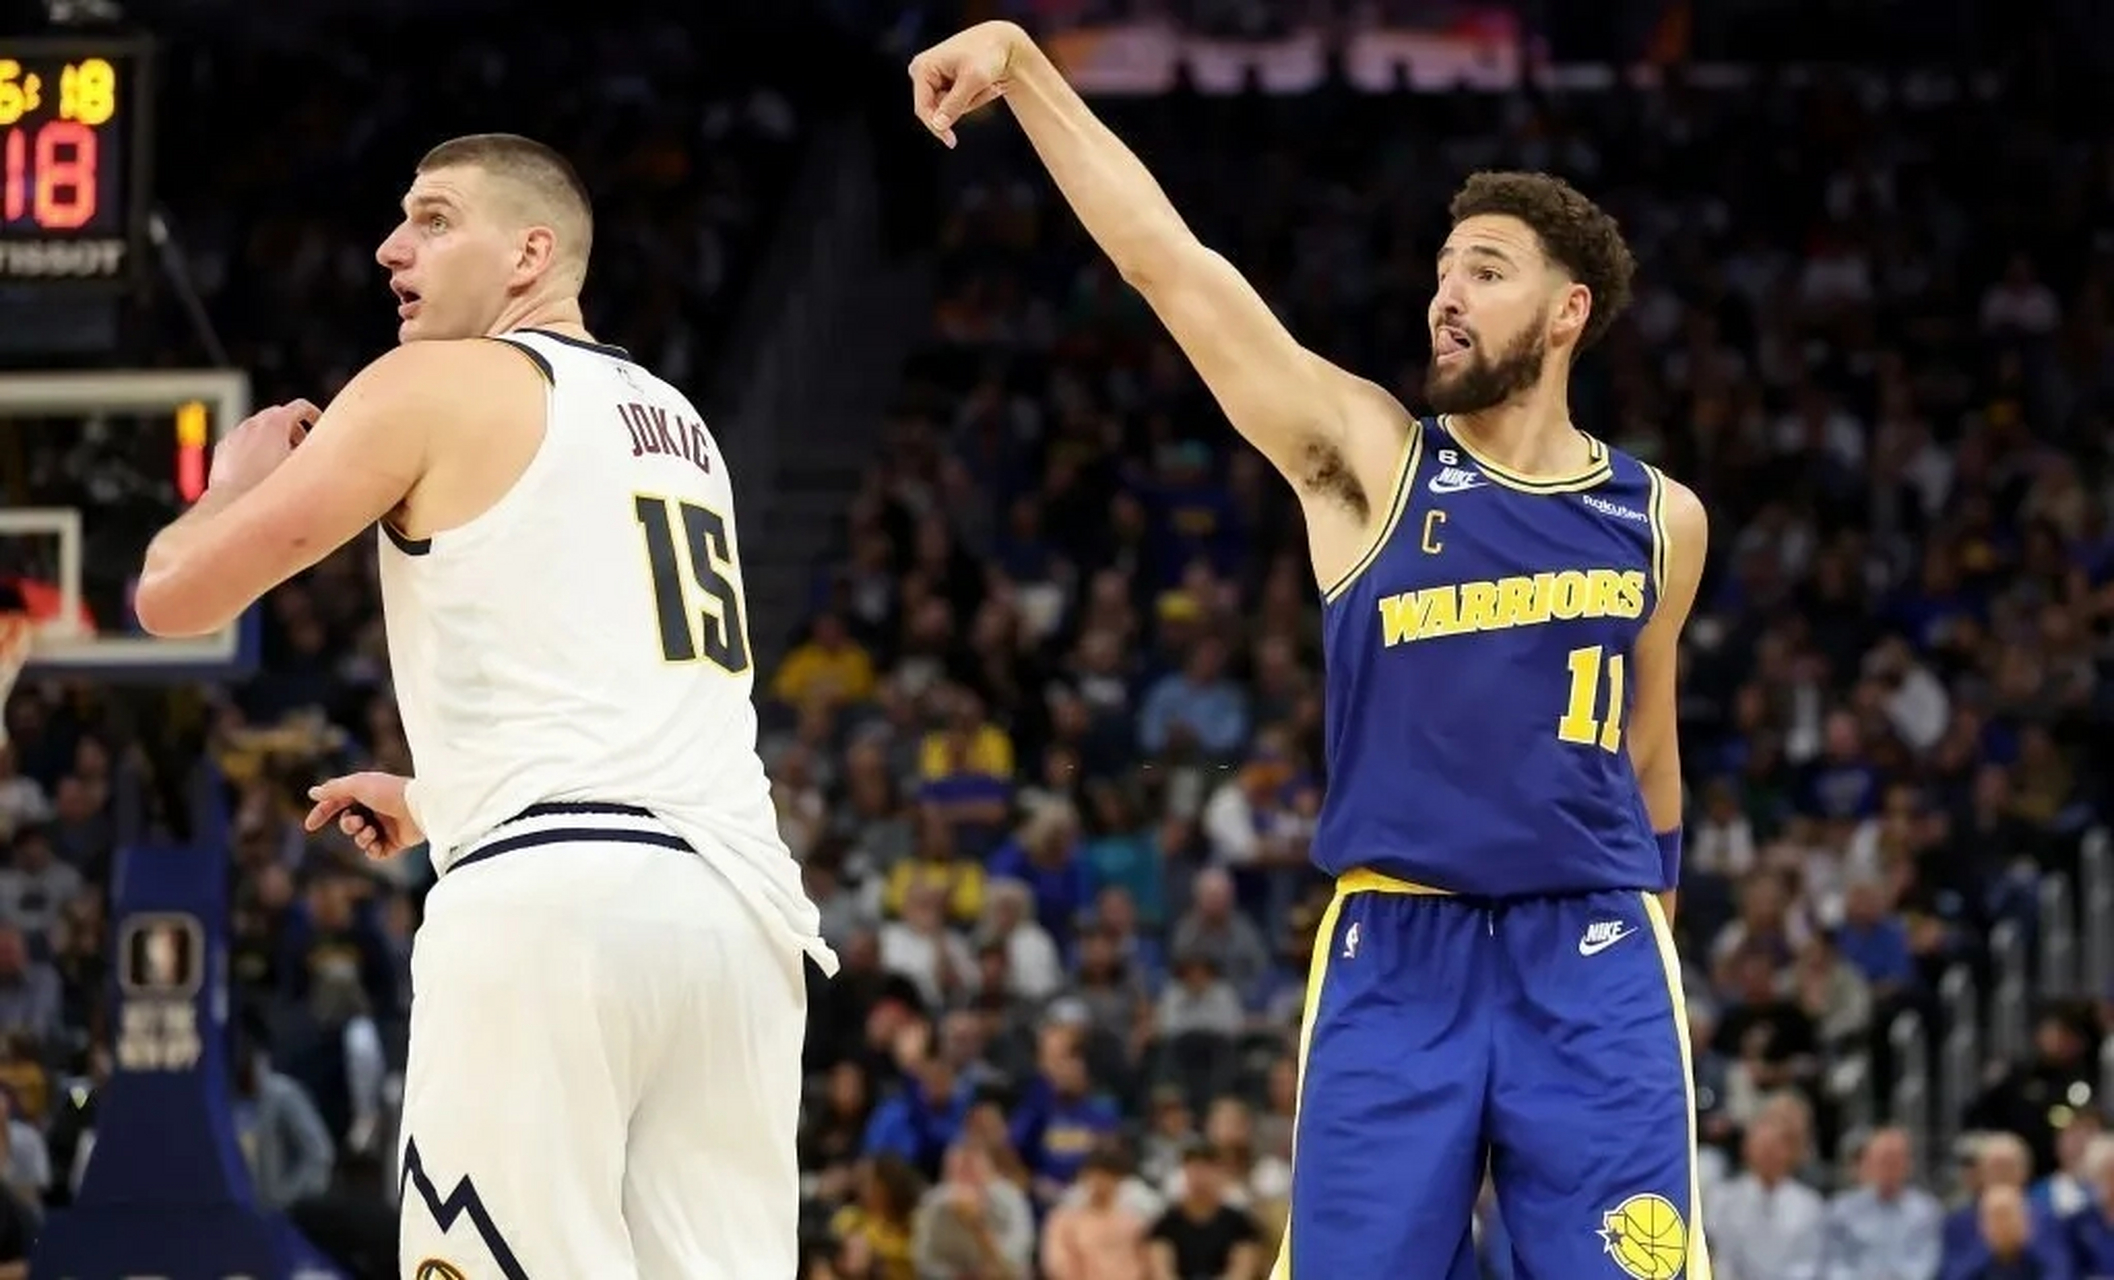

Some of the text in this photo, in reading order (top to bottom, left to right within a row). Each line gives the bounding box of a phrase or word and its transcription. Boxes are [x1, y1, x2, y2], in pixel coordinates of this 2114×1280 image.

[5, 121, 97, 228] 18
[1437, 466, 1479, 488] NIKE
[1438, 449, 1459, 466] 6
[1421, 509, 1447, 554] C
[633, 492, 750, 676] 15
[1379, 569, 1646, 648] WARRIORS
[1558, 645, 1624, 754] 11
[1584, 920, 1624, 942] NIKE
